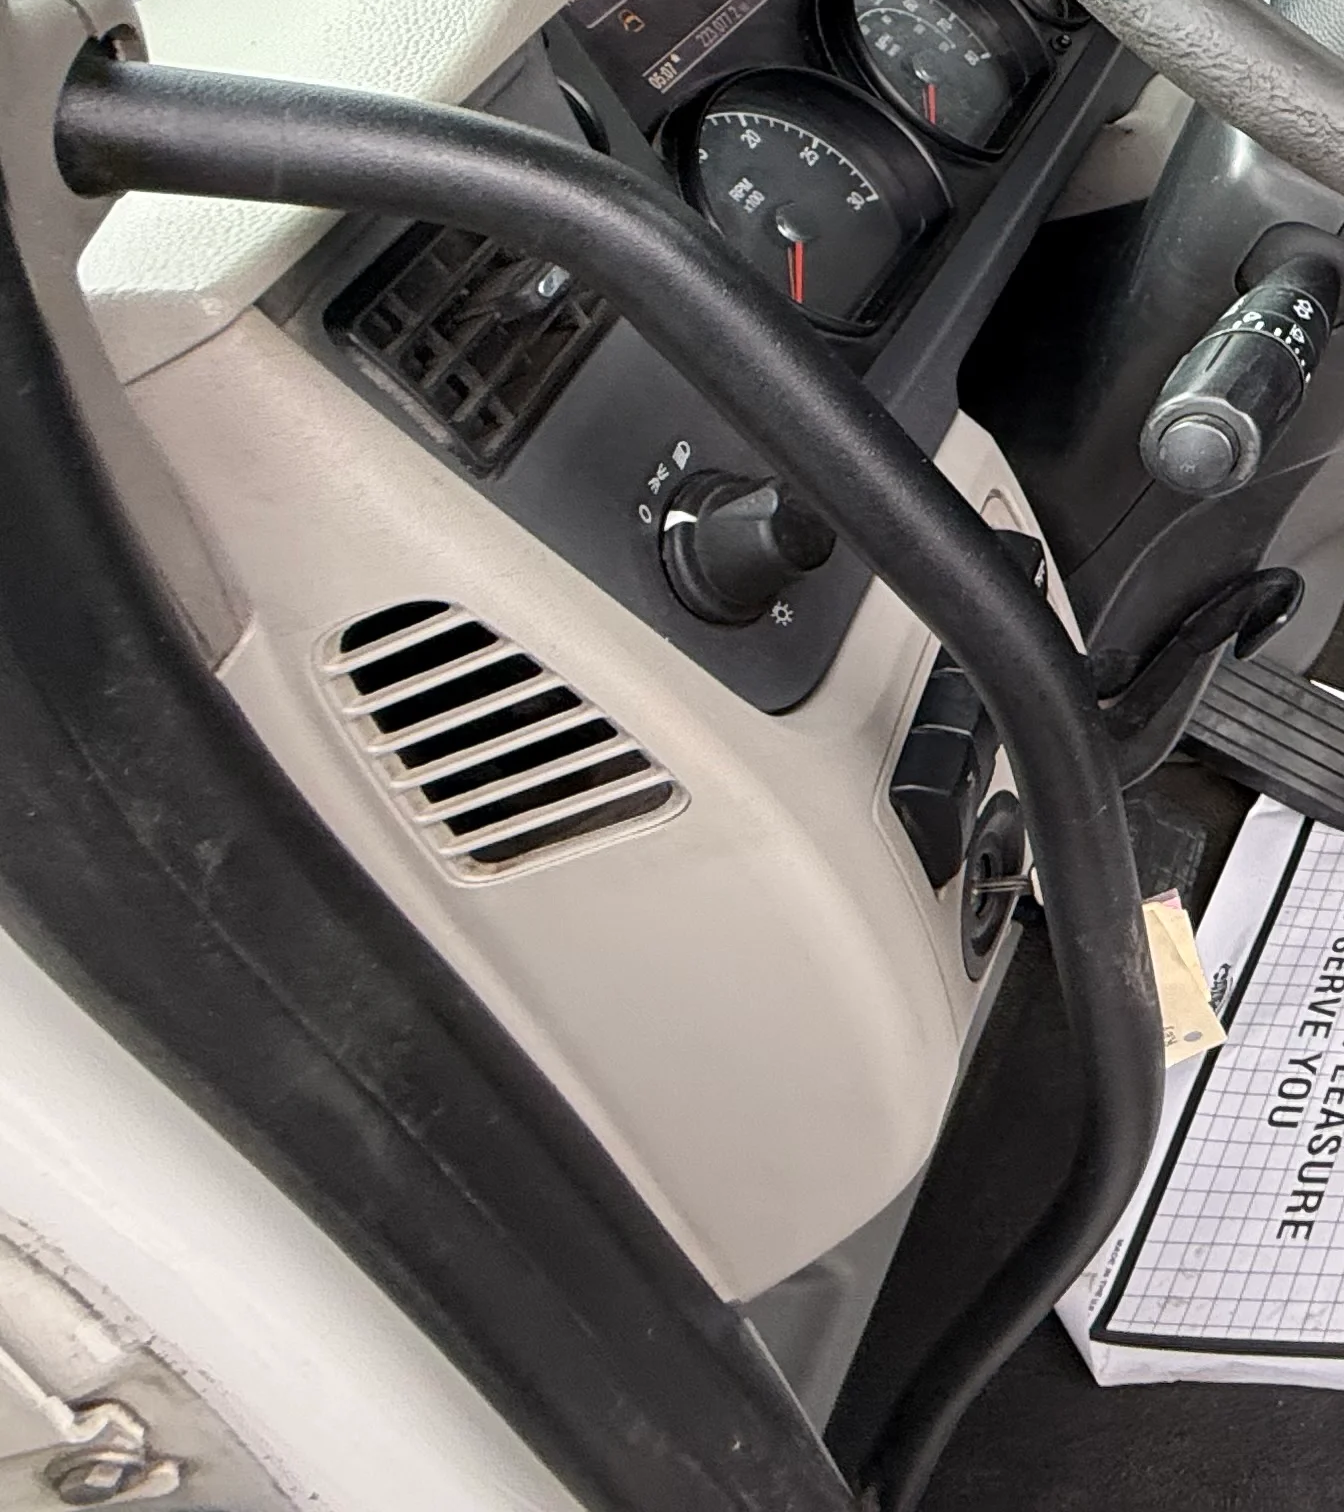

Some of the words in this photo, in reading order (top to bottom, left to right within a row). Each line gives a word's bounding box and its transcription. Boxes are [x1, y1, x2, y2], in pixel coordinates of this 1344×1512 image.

[648, 64, 678, 90] 05:07
[740, 129, 761, 150] 20
[846, 191, 866, 211] 30
[1266, 1051, 1323, 1129] YOU
